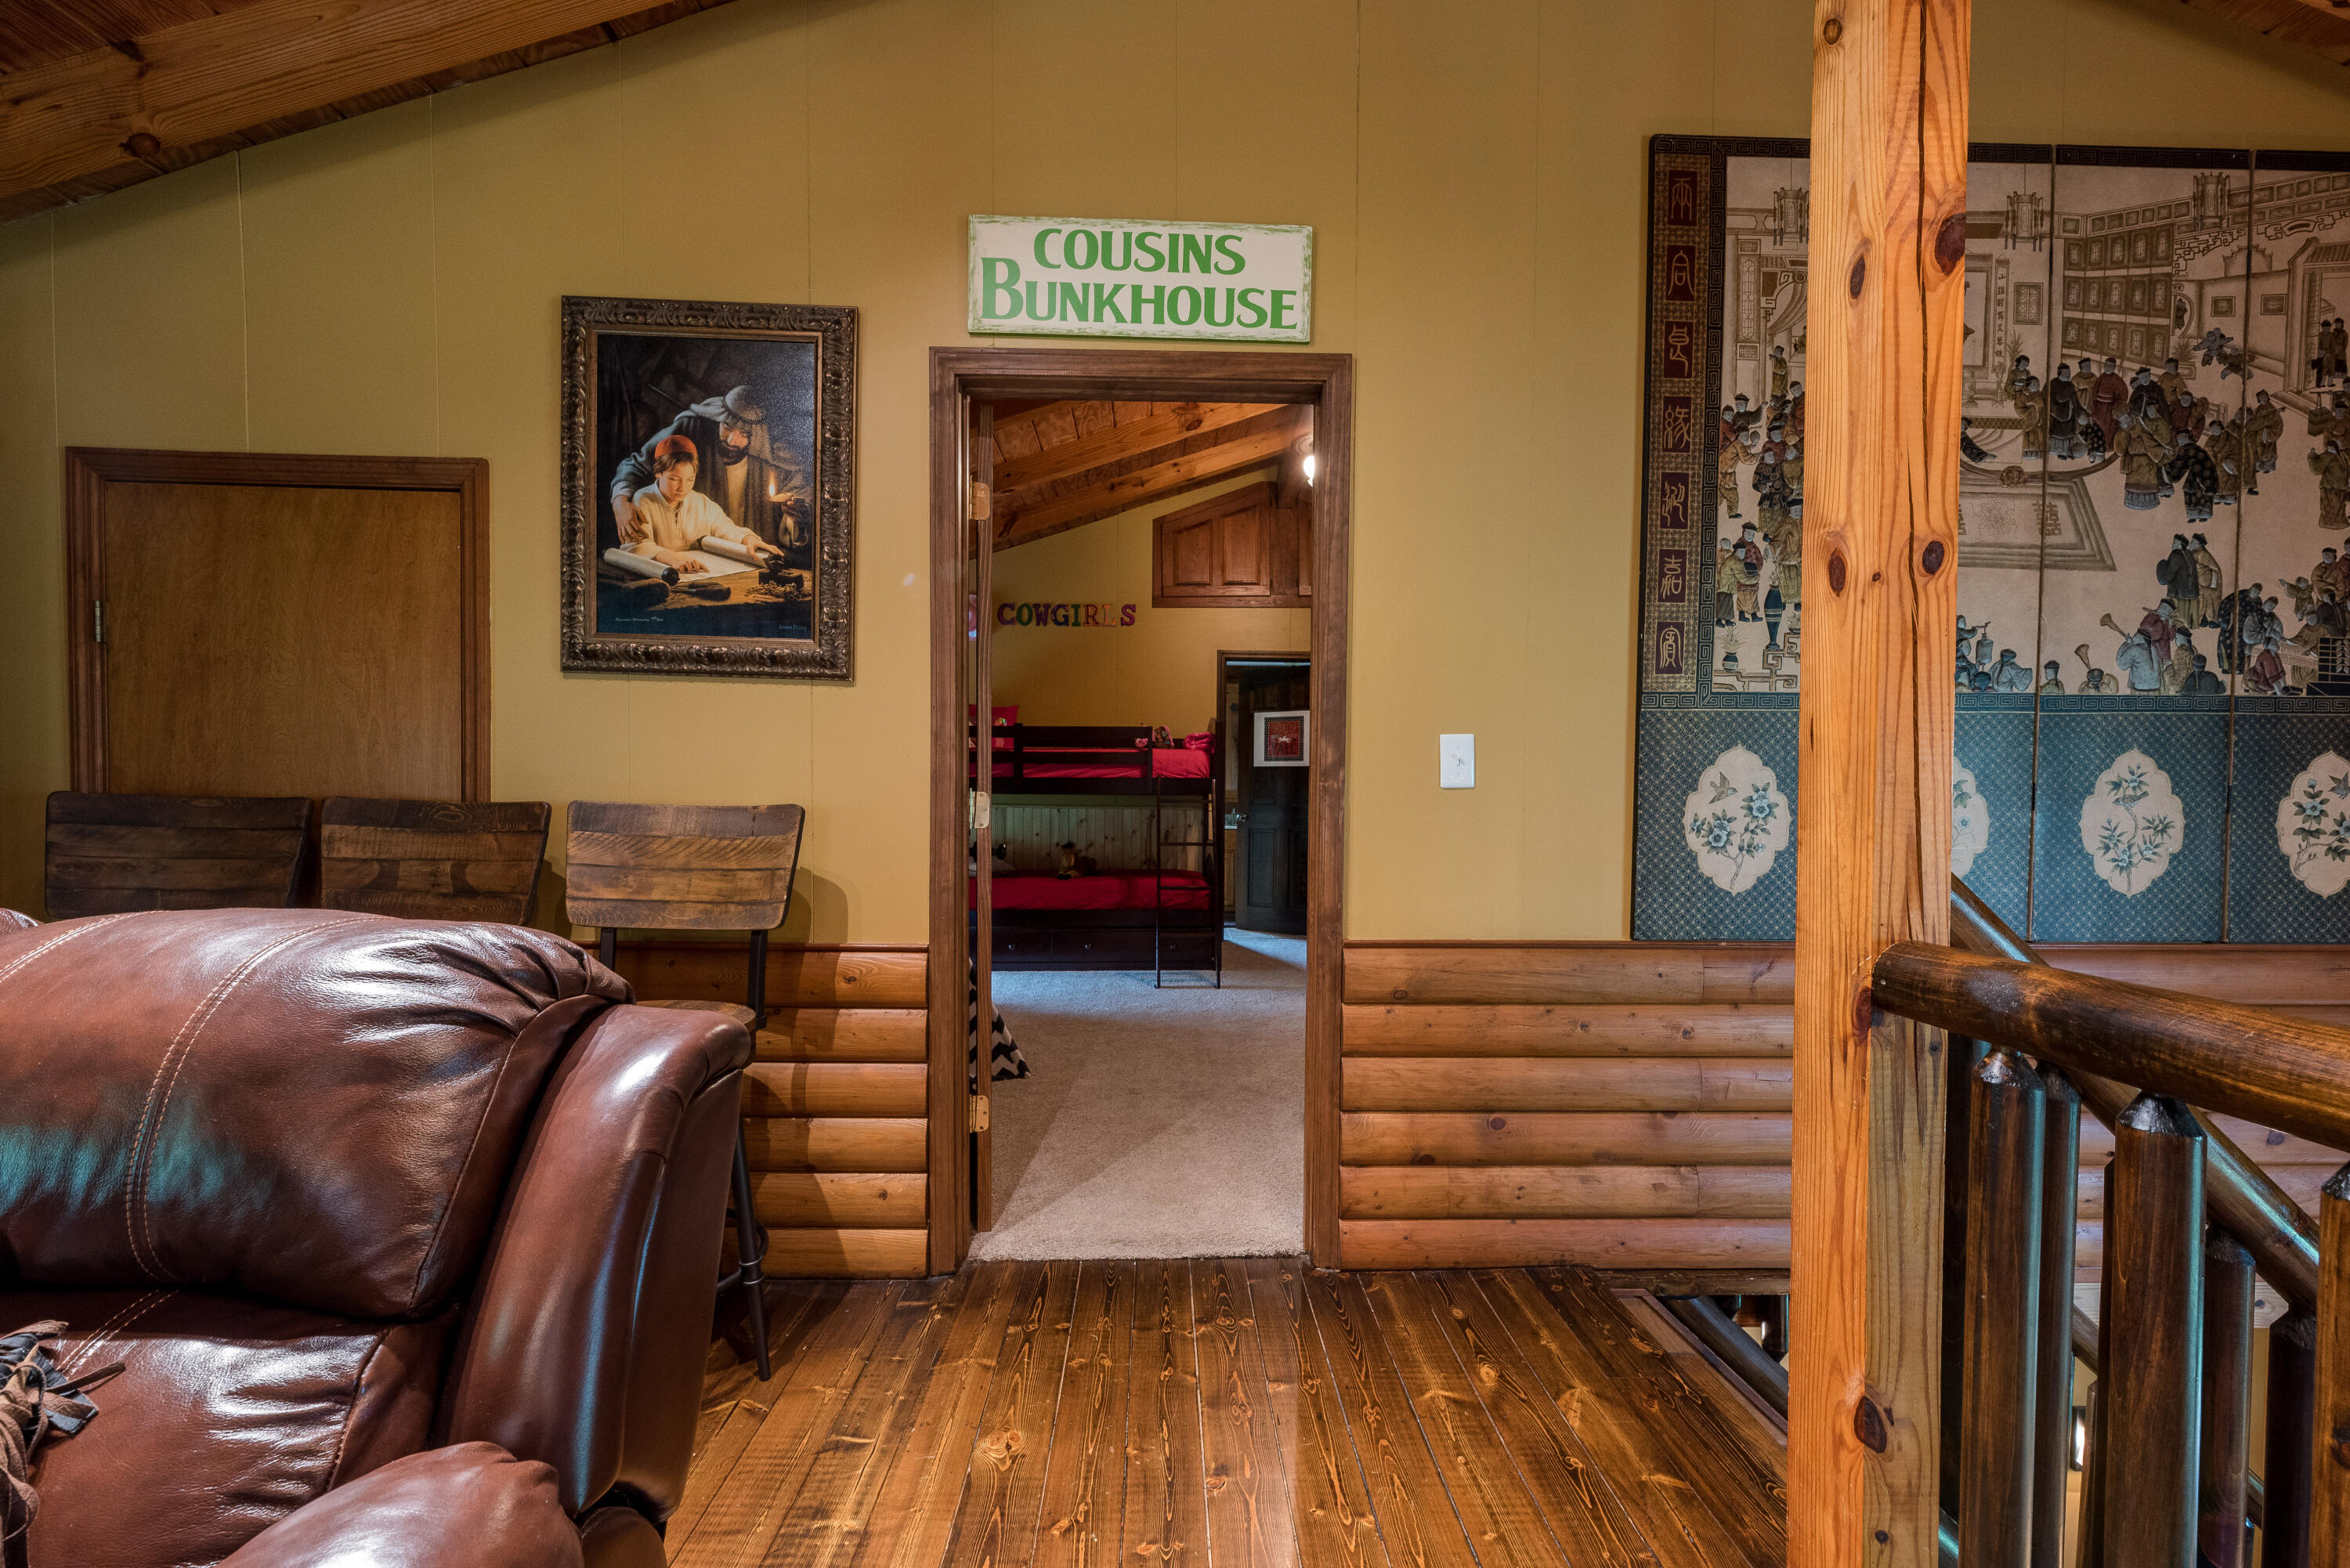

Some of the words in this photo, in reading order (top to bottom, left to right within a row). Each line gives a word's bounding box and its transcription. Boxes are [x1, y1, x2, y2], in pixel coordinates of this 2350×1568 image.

[1033, 228, 1246, 275] COUSINS
[980, 257, 1297, 330] BUNKHOUSE
[996, 602, 1137, 627] COWGIRLS
